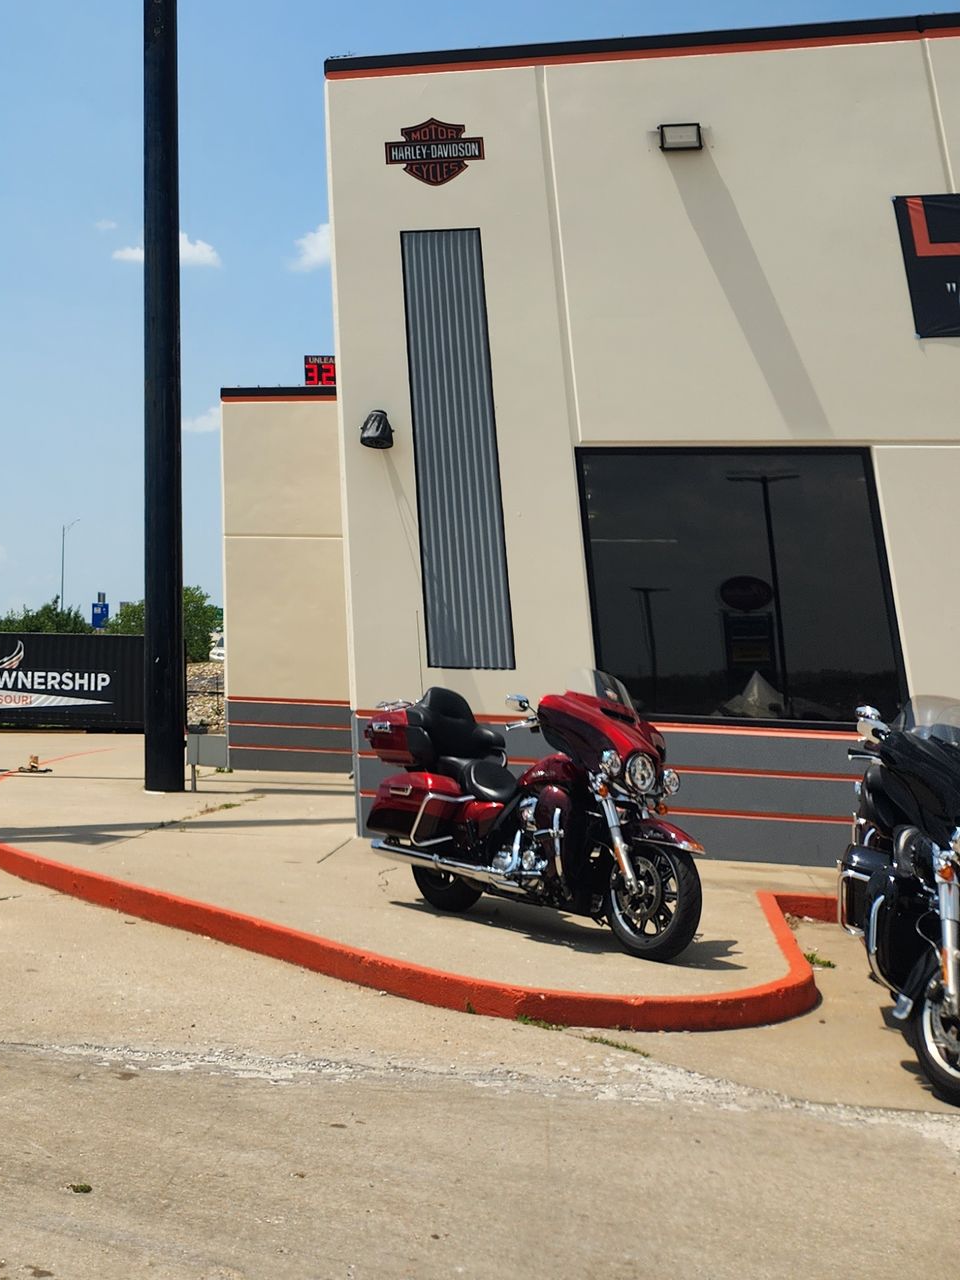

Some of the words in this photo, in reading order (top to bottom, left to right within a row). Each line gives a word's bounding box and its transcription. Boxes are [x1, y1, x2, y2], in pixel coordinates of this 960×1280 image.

[411, 124, 457, 141] MOTOR
[391, 142, 479, 161] HARLEY-DAVIDSON
[412, 162, 459, 182] CYCLES
[308, 356, 334, 364] UNLEA
